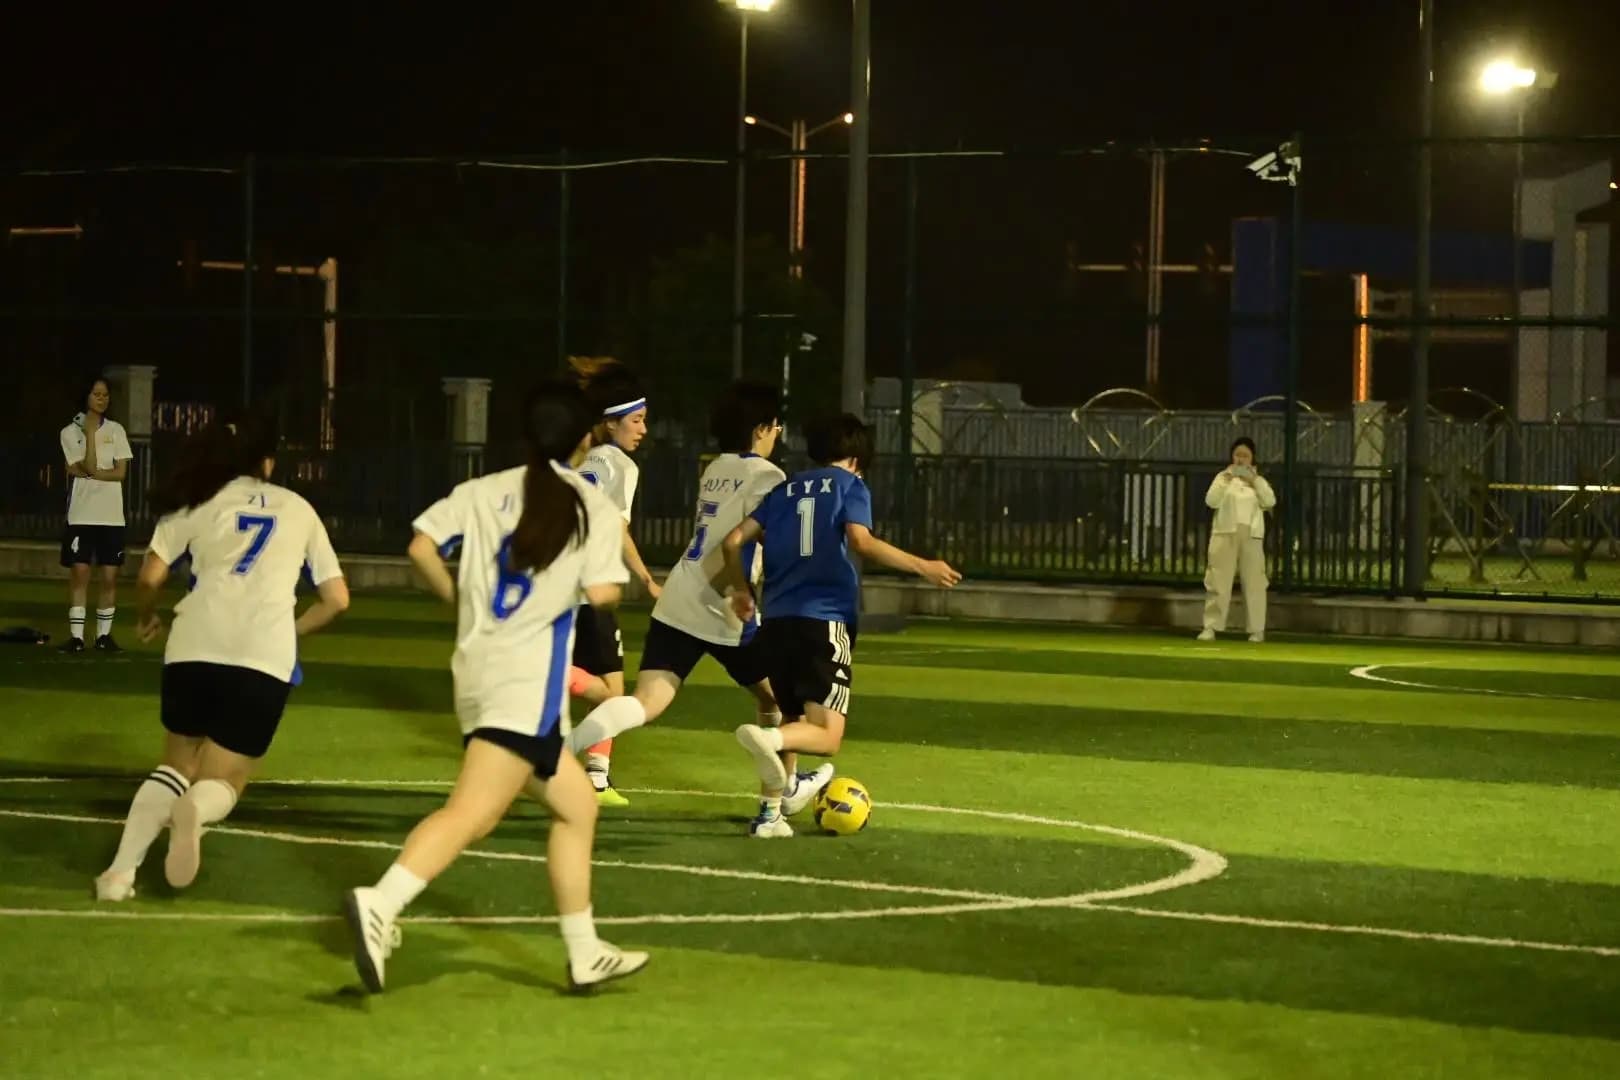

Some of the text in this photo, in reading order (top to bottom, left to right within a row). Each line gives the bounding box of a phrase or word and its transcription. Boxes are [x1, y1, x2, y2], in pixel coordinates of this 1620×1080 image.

[70, 535, 80, 554] 4
[231, 511, 278, 575] 7
[683, 499, 720, 561] 5
[796, 497, 816, 557] 1
[491, 533, 533, 620] 6
